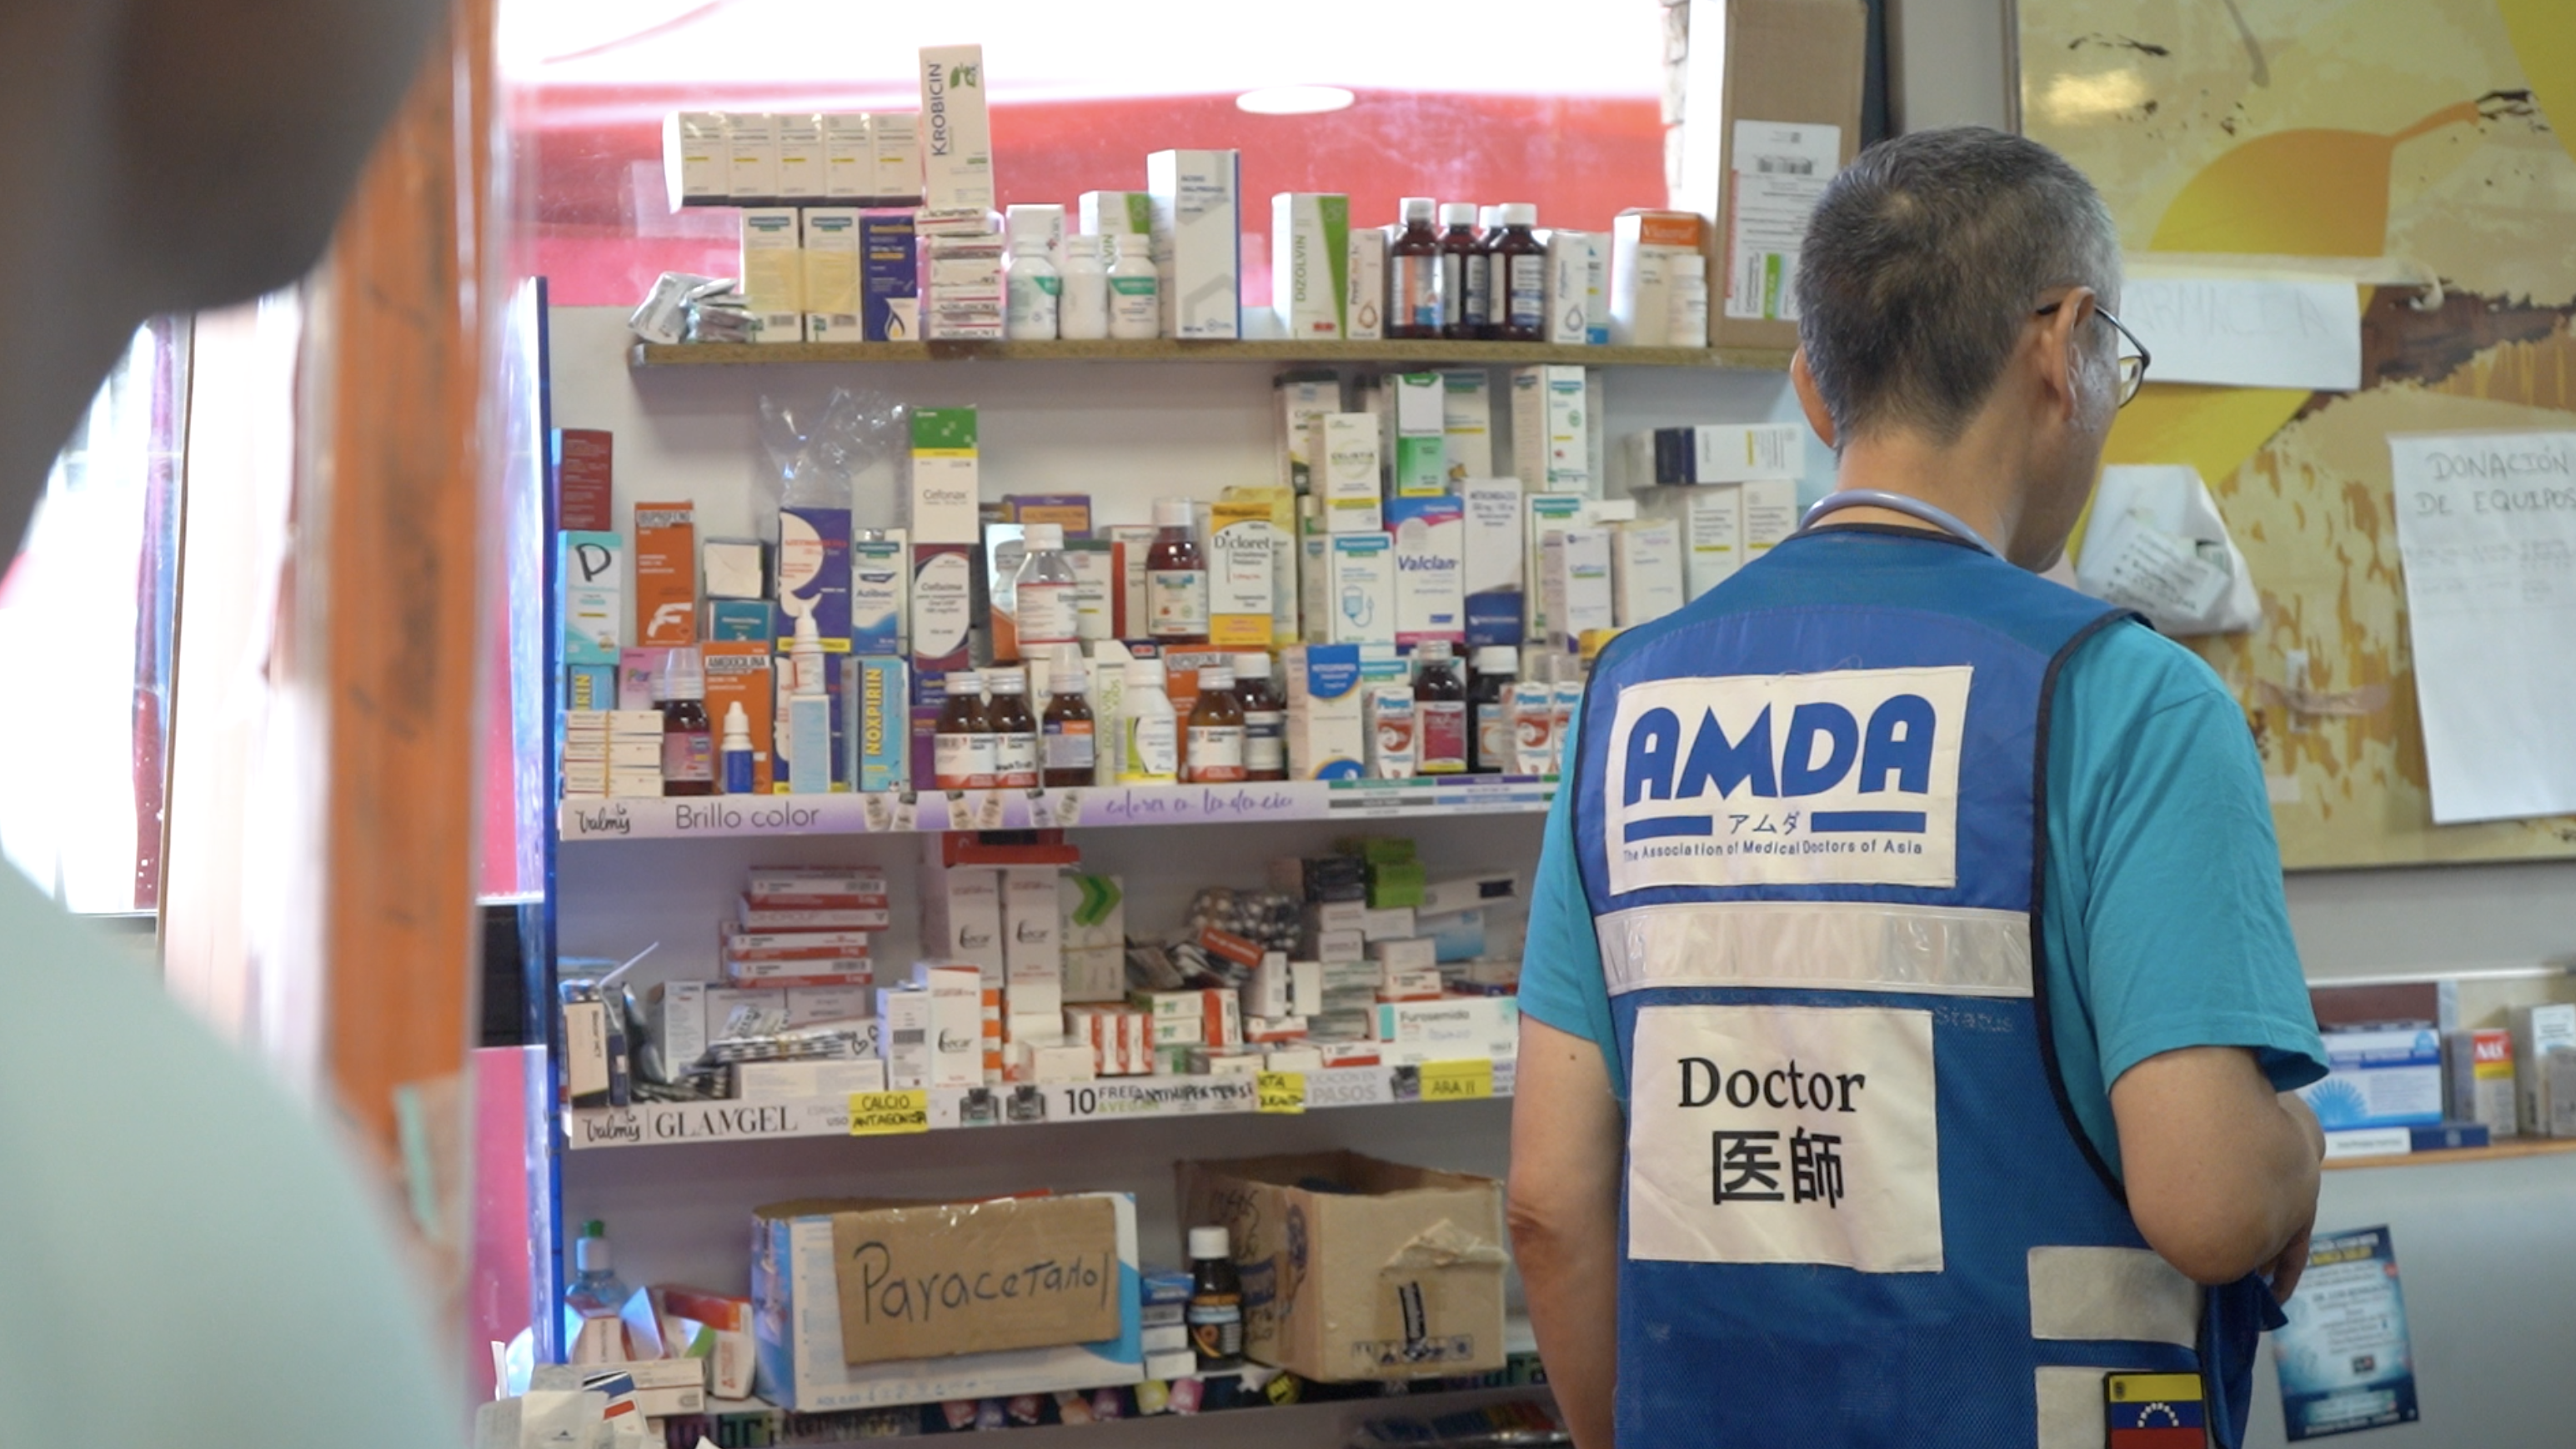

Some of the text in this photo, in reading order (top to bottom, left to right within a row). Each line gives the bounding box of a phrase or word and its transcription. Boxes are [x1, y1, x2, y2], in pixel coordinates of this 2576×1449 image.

[928, 63, 948, 157] KROBICIN
[1102, 233, 1115, 269] LVIN
[1295, 234, 1306, 302] DIZOLVIN
[2425, 447, 2570, 480] DONACIÓN
[923, 489, 967, 501] Cefonax
[2414, 490, 2453, 515] DE
[1398, 554, 1456, 571] Valclan
[865, 668, 882, 756] NOXPIRIN
[1624, 694, 1937, 808] AMDA
[675, 804, 742, 830] Brillo
[751, 805, 820, 829] color
[1727, 811, 1801, 836] アムダ
[1641, 842, 1723, 859] Association
[1727, 844, 1740, 855] of
[1743, 840, 1800, 855] Medical
[1802, 840, 1855, 855] Doctors
[1861, 838, 1877, 853] of
[1883, 839, 1922, 855] Asia
[1312, 1085, 1377, 1105] PASOS
[1431, 1080, 1461, 1095] ARA
[1677, 1056, 1866, 1113] Doctor
[862, 1094, 910, 1111] CALCIO
[1065, 1087, 1096, 1115] 10
[1711, 1127, 1844, 1208] 医師
